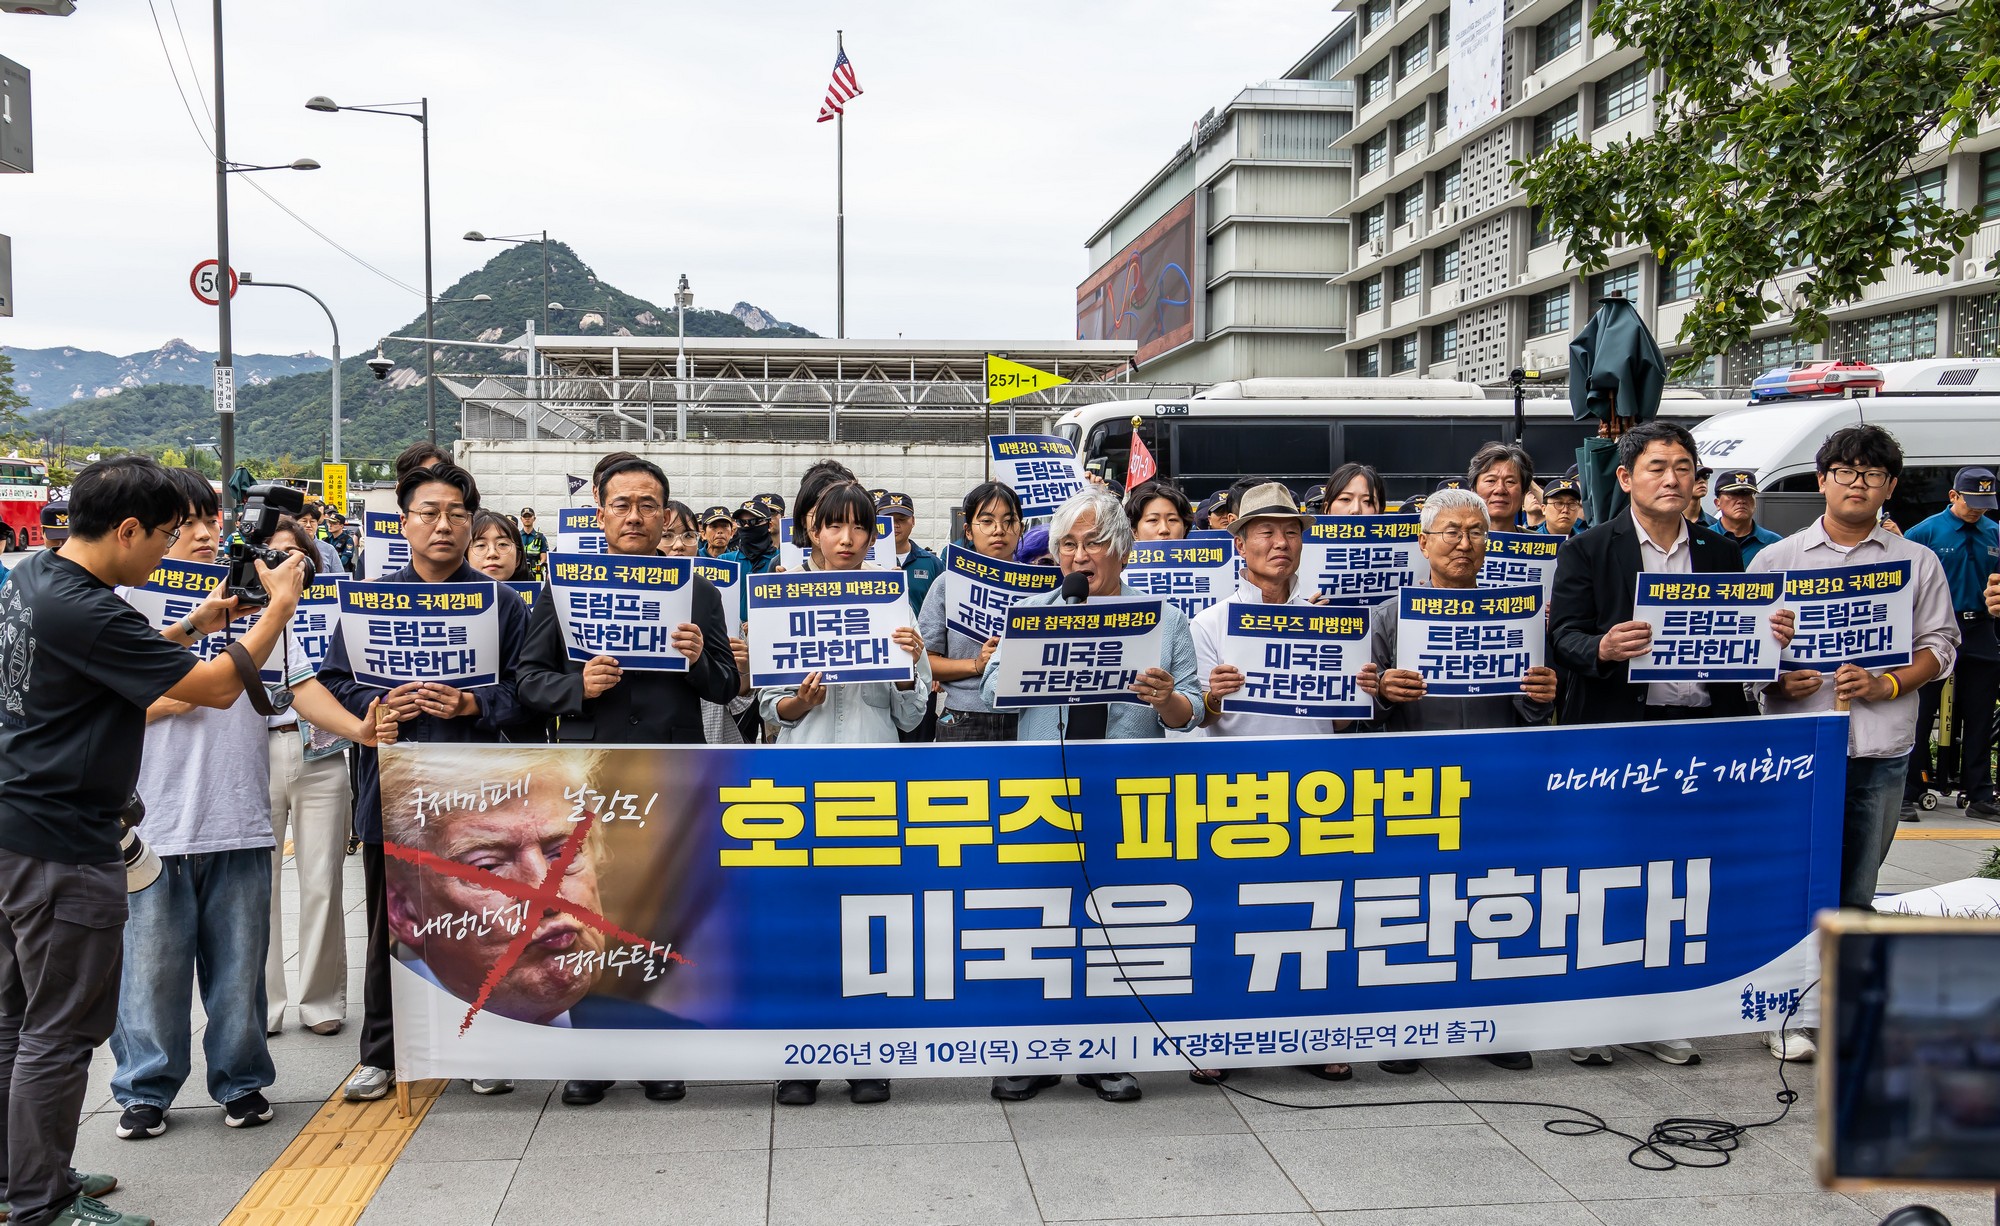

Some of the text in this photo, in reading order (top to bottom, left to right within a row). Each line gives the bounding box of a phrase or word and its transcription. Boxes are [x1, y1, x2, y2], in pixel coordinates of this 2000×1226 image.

[990, 373, 1037, 388] 25기-1
[998, 442, 1073, 456] 파병강요 국제깡패
[1015, 461, 1076, 482] 트럼프를
[1311, 524, 1366, 539] 파병강요
[1170, 548, 1223, 563] 국제깡패
[1325, 547, 1409, 570] 트럼프를
[1508, 541, 1557, 556] 국제깡패
[148, 568, 219, 592] 파병강요
[556, 563, 679, 585] 파병강요 국제깡패
[955, 556, 1057, 589] 호르무즈 파병압박
[1127, 572, 1210, 594] 트럼프를
[1785, 569, 1902, 596] 파병강요 국제깡패
[349, 591, 483, 610] 파병강요 국제깡패
[754, 581, 902, 599] 이란 침략전쟁 파병강요
[1649, 582, 1774, 600] 파병강요 국제깡패
[570, 592, 661, 621] 트럼프를
[1411, 595, 1535, 616] 파병강요 국제깡패
[1799, 600, 1888, 630] 트럼프를
[368, 619, 468, 647] 트럼프를
[789, 608, 870, 637] 미국을
[1012, 612, 1157, 630] 이란 침략전쟁 파병강요
[1239, 614, 1364, 635] 호르무즈 파병압박
[1661, 610, 1756, 636] 트럼프를
[569, 621, 667, 652] 규탄한다!
[1427, 625, 1524, 650] 트럼프를
[1790, 626, 1893, 659] 규탄한다!
[364, 648, 476, 677] 규탄한다!
[772, 638, 890, 669] 규탄한다!
[1041, 641, 1123, 667] 미국을
[1265, 643, 1343, 671] 미국을
[1418, 652, 1530, 680] 규탄한다!
[1652, 639, 1760, 666] 규탄한다!
[1245, 671, 1357, 702] 규탄한다!
[1547, 748, 1814, 794] 미대사관 앞 기자회견
[409, 773, 531, 827] 국제깡패!
[563, 783, 658, 828] 날강도!
[719, 765, 1470, 867] 호르무즈 파병압박
[413, 900, 531, 940] 내정간섭!
[840, 857, 1711, 1000] 미국을 규탄한다!
[555, 941, 672, 982] 경제수탈!
[1741, 983, 1801, 1022] 촛불행동
[784, 1042, 872, 1066] 2026년
[879, 1041, 918, 1066] 9월
[925, 1040, 1018, 1065] 10일(목)
[1026, 1038, 1072, 1061] 오후
[1078, 1037, 1116, 1060] 2시
[1404, 1021, 1439, 1045] 2번
[1445, 1019, 1496, 1043] 출구)
